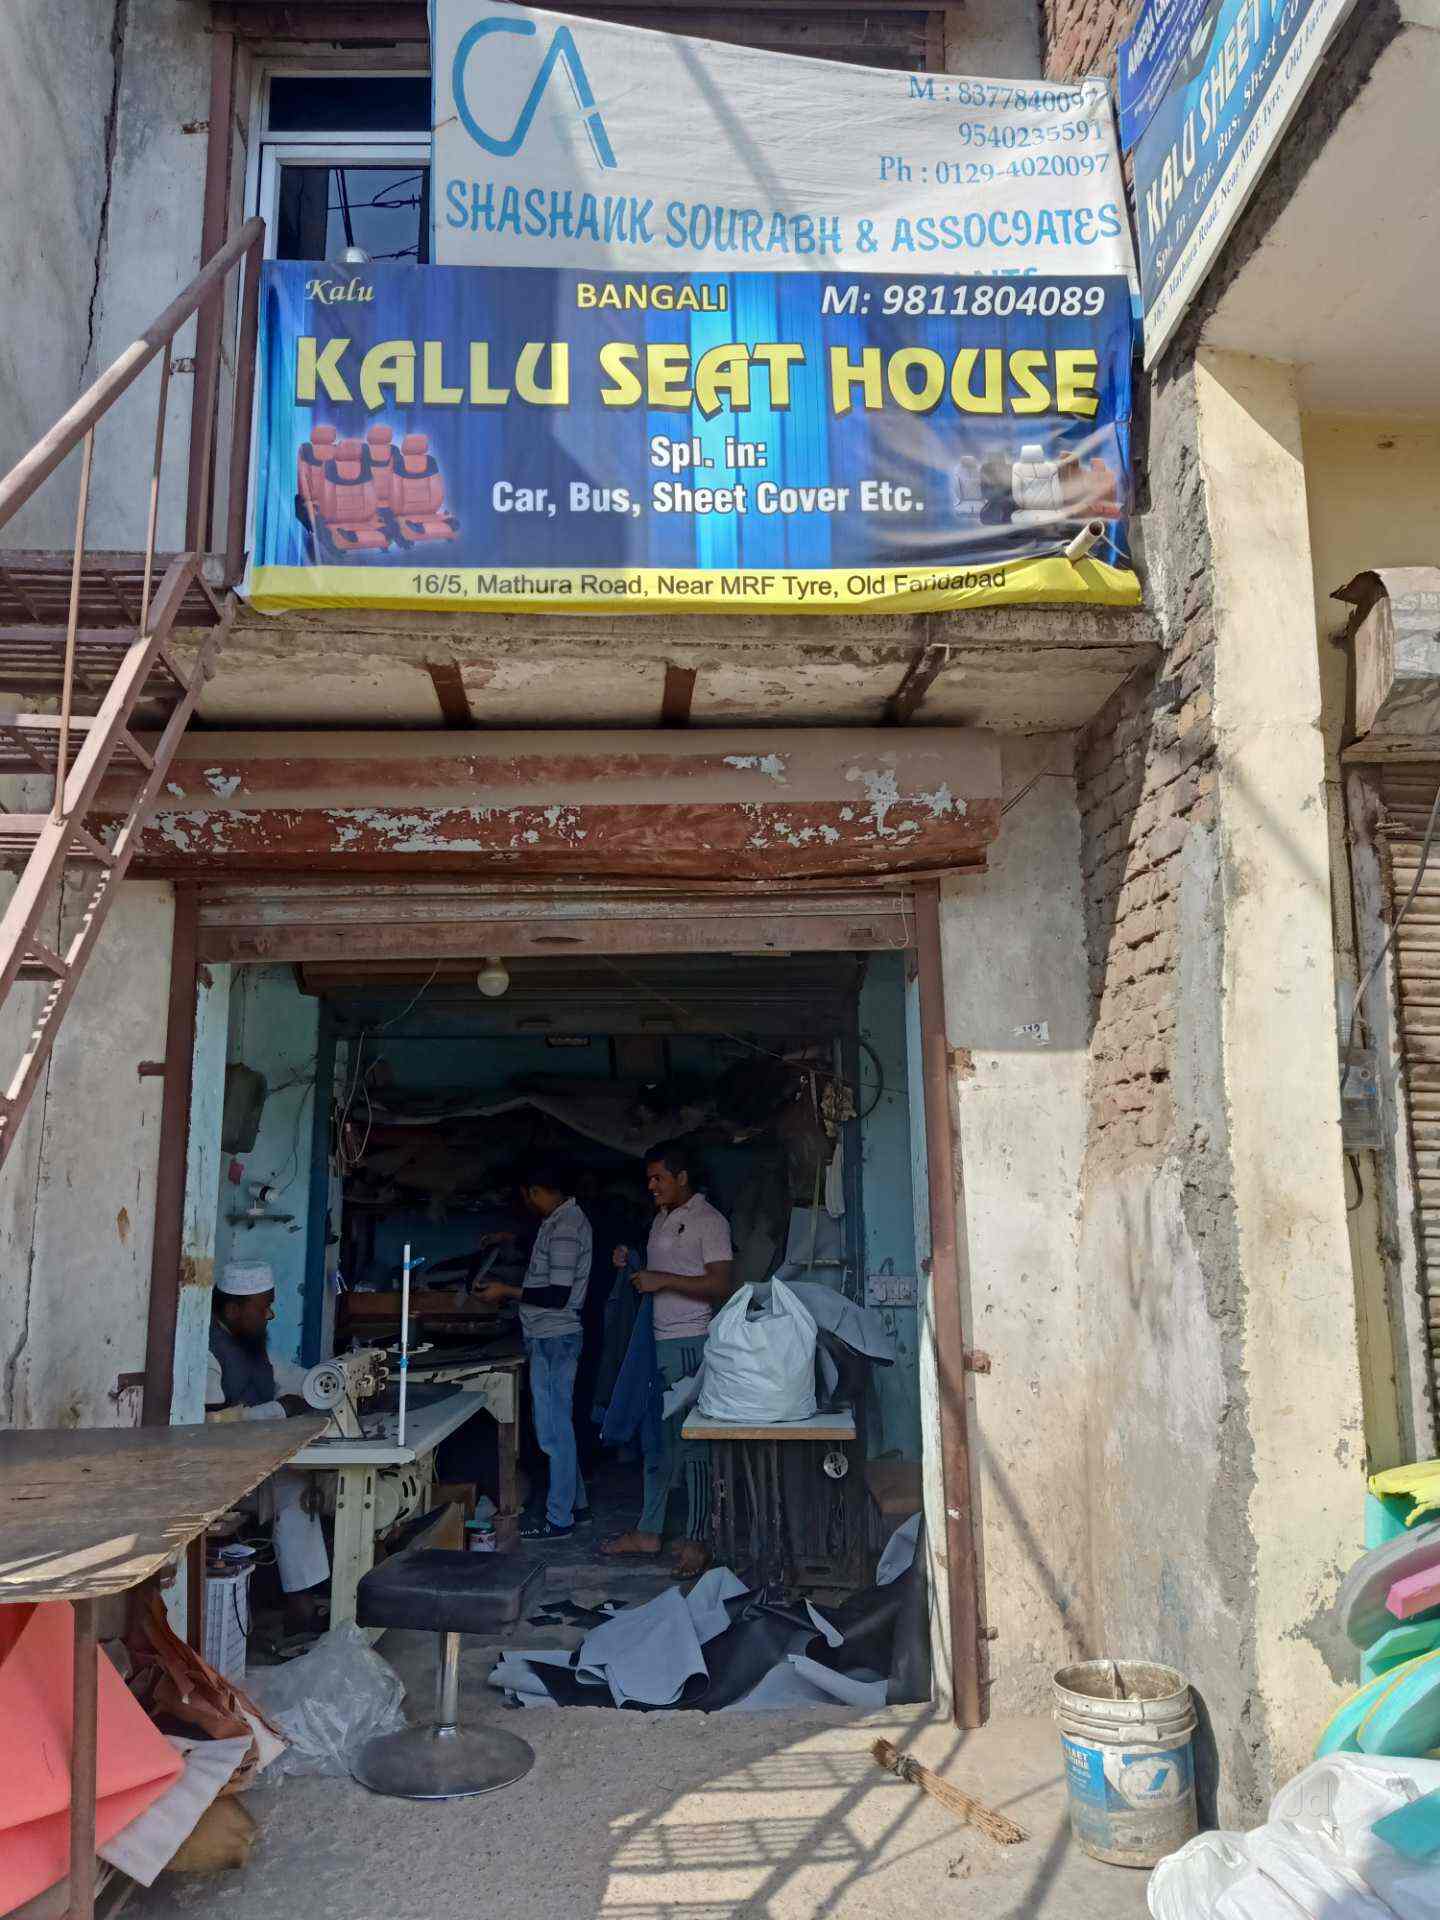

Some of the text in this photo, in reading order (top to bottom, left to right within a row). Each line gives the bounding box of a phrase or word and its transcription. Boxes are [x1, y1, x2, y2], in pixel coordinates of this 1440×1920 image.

[908, 76, 936, 100] M
[959, 120, 1104, 148] 9540235591
[880, 155, 912, 182] Ph
[935, 153, 1109, 184] 0129-4020097
[1146, 110, 1196, 249] KALU
[446, 179, 655, 244] SHASHANK
[666, 202, 843, 255] SOURABH
[857, 218, 878, 252] &
[304, 277, 375, 303] Kalu
[577, 283, 727, 312] BANGALI
[821, 285, 1105, 317] M: 9811804089
[296, 336, 1100, 419] KALLU SEAT HOUSE
[649, 435, 767, 474] Spl. in:
[492, 480, 924, 518] Car, Bus, Sheet Cover Etc.
[412, 568, 1007, 603] 16/5, Mathura Road, Near MRF Tyre, Old Faridabad
